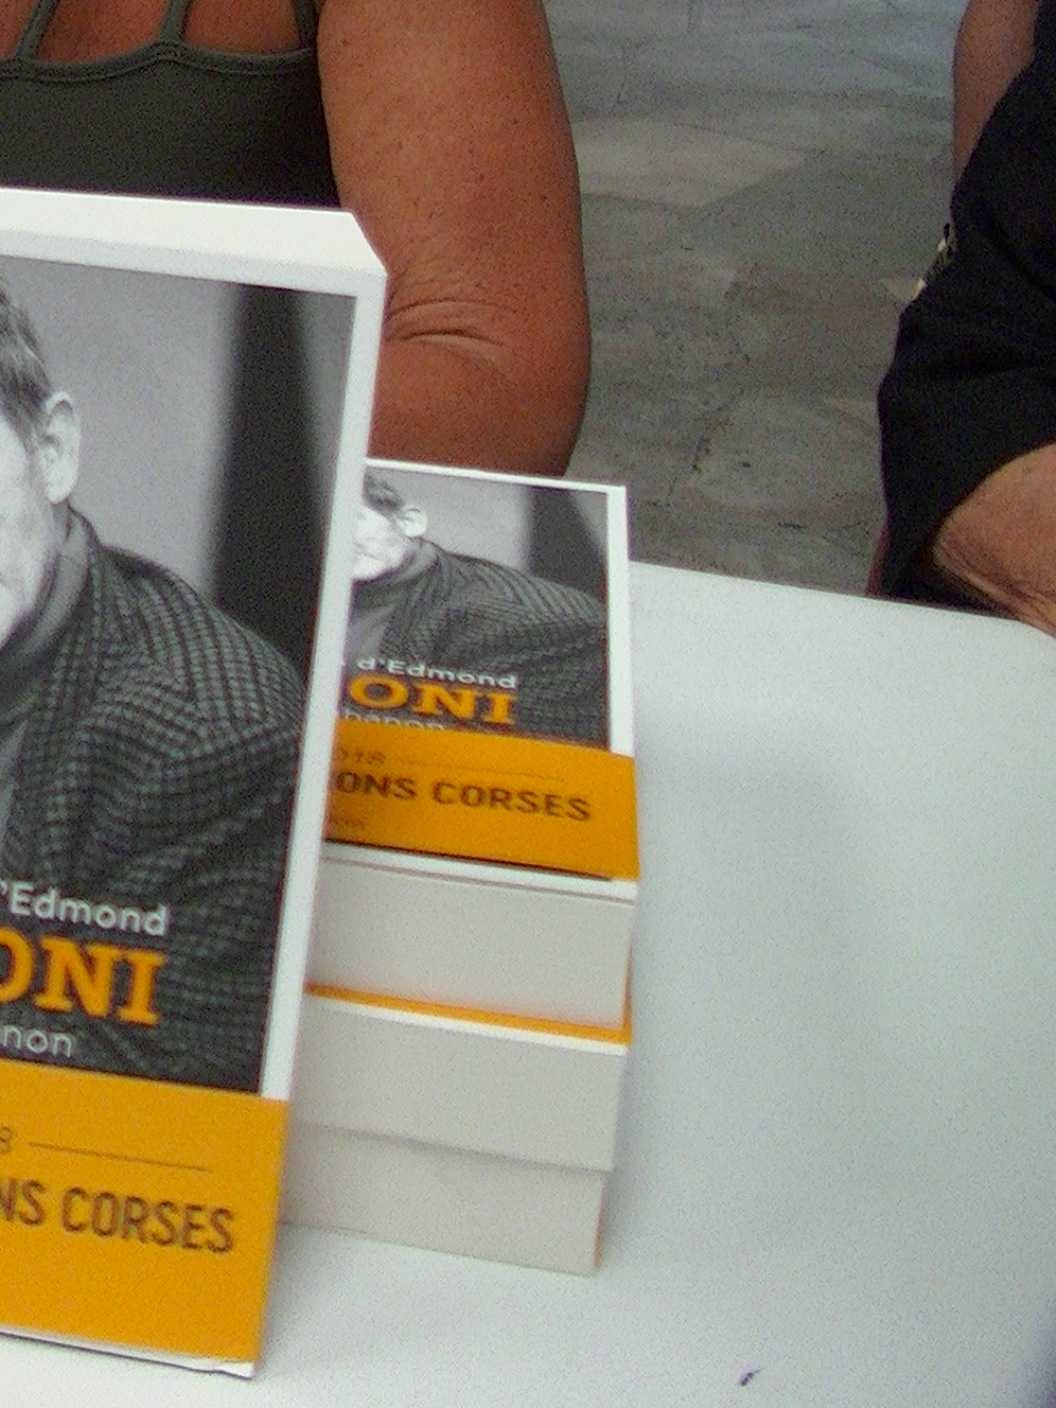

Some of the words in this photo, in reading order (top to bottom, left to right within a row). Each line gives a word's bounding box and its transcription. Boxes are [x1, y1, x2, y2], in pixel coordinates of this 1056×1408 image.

[356, 656, 517, 689] d'Edmond
[430, 779, 592, 823] CORSES
[60, 1185, 234, 1255] CORSES
